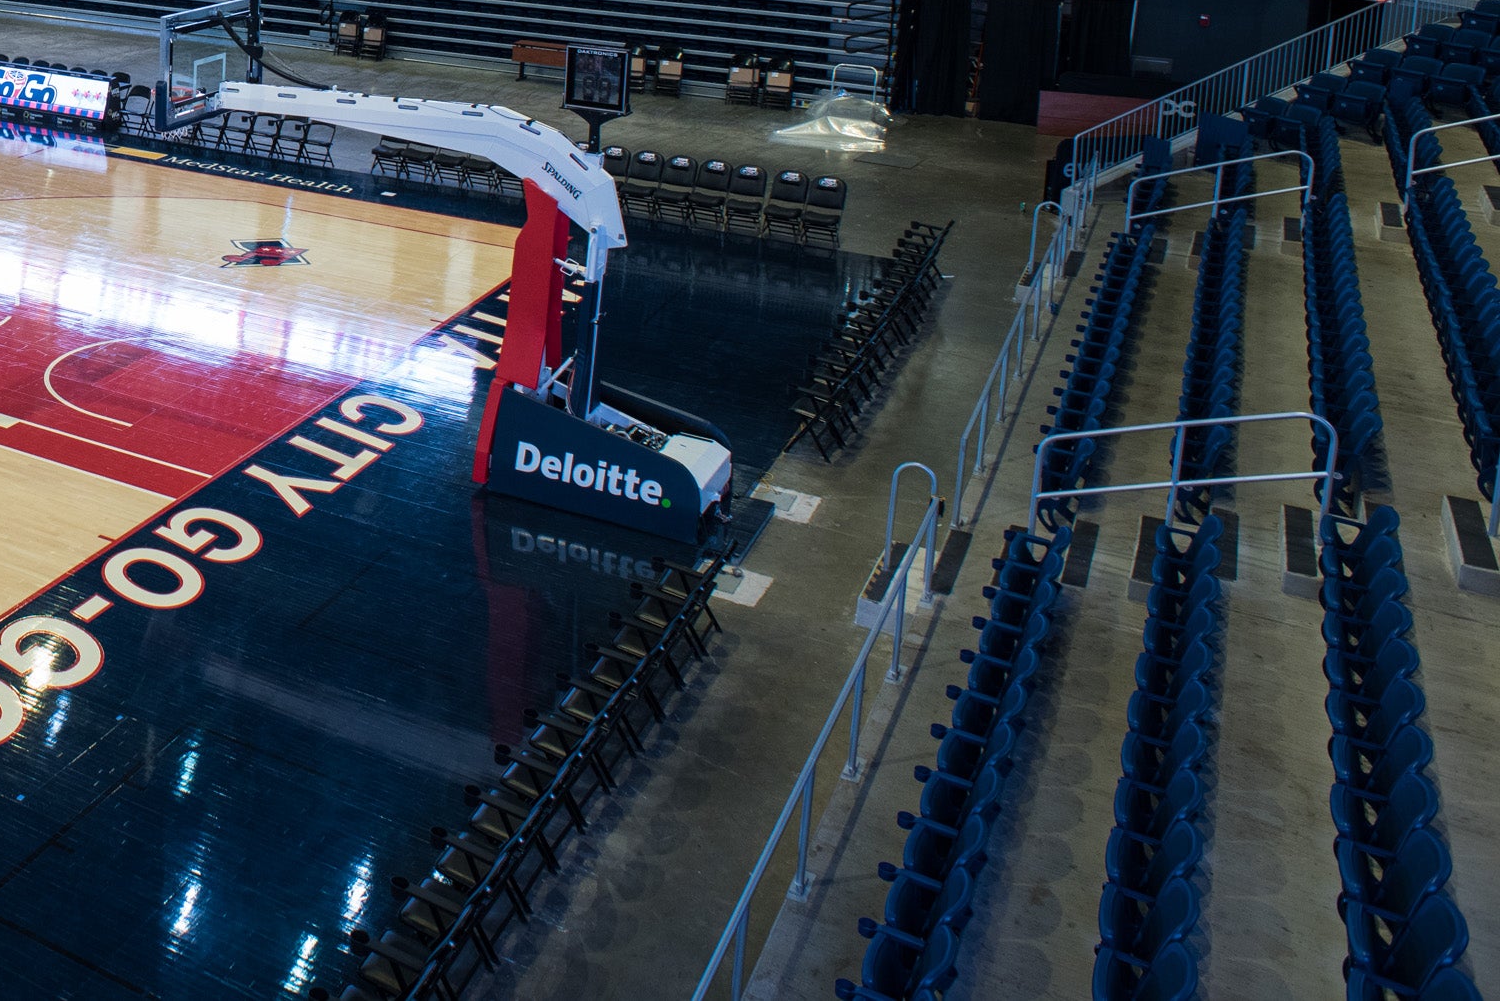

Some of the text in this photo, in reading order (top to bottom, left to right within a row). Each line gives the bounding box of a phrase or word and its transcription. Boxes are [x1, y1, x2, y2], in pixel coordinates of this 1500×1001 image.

[162, 155, 355, 194] MedStar Health
[541, 161, 583, 201] SPALDING
[243, 394, 425, 518] CITY
